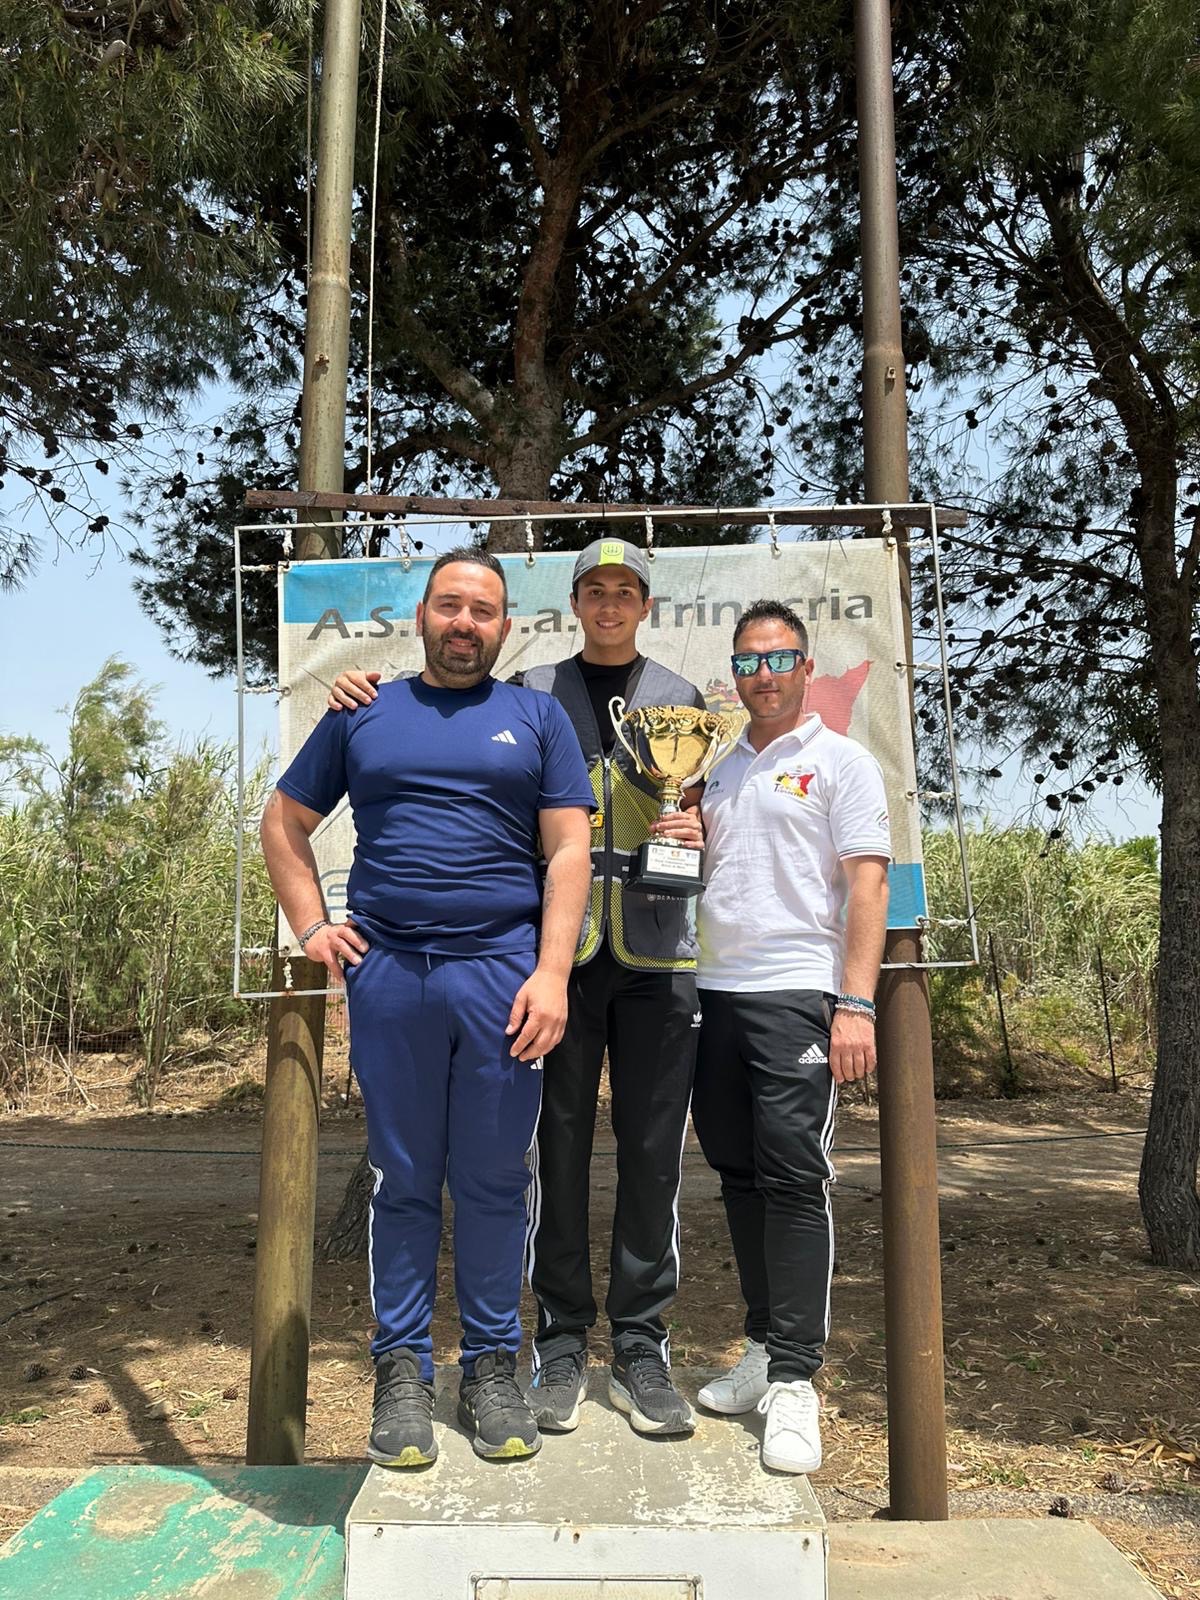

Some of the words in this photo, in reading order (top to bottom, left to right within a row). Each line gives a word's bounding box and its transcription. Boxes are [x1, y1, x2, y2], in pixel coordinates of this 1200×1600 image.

[306, 606, 423, 640] A.S.
[650, 588, 873, 629] Trincria
[798, 1056, 828, 1064] adidas
